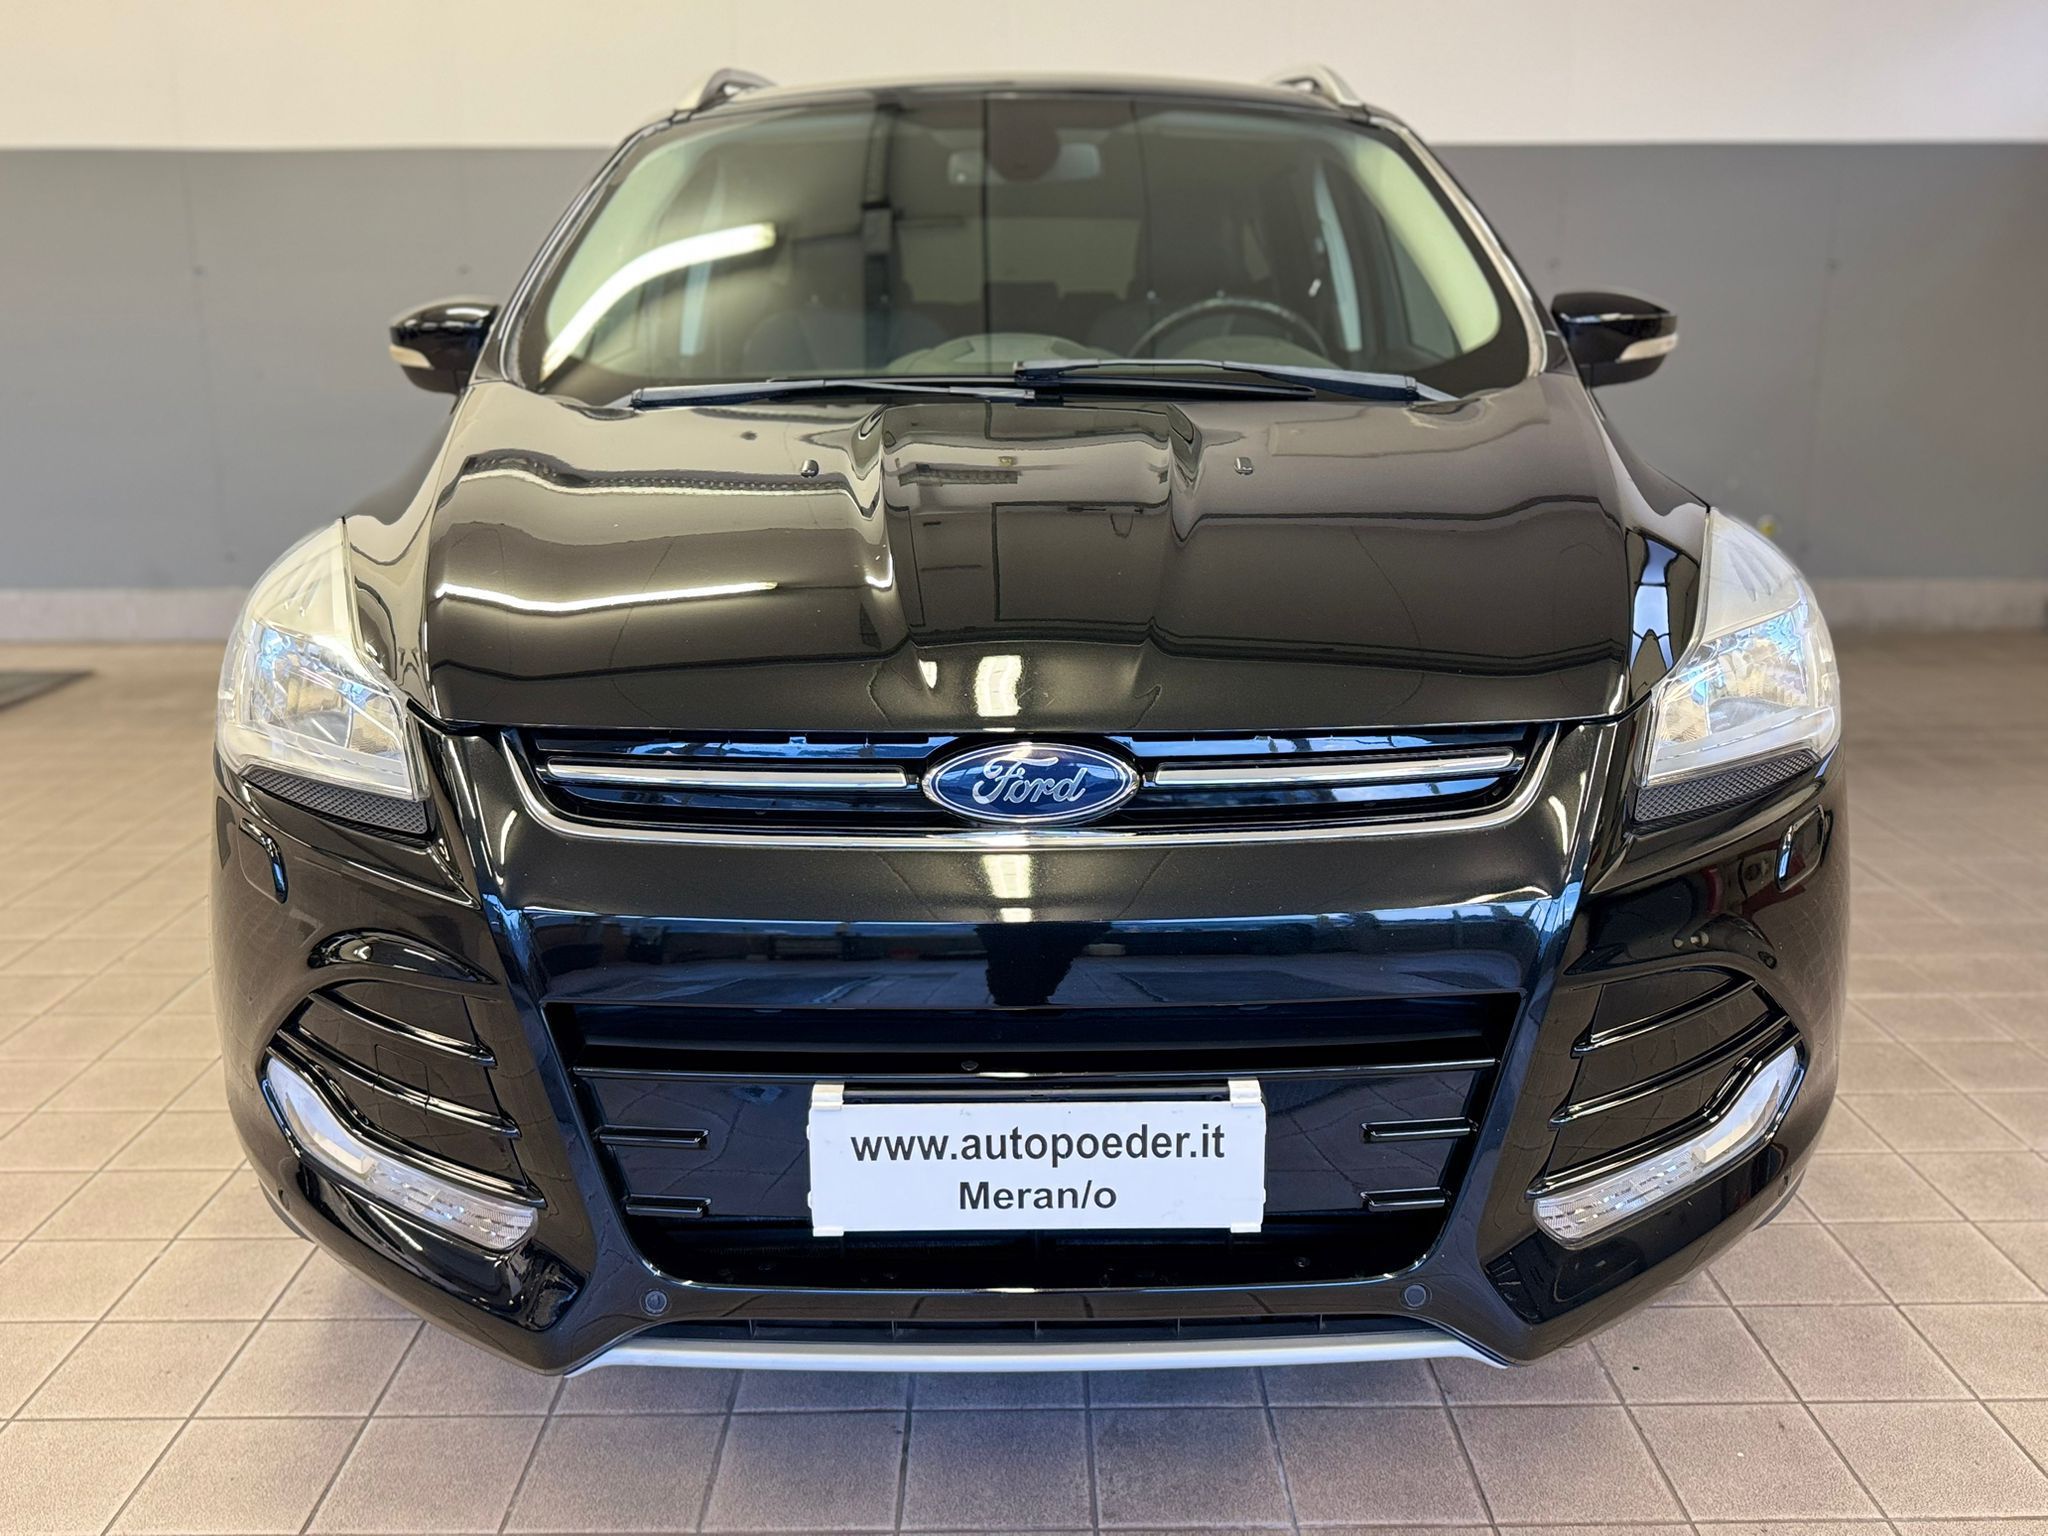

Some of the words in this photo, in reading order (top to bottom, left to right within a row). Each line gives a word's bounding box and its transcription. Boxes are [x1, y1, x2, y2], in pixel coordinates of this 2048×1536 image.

[971, 756, 1088, 804] Ford
[850, 1123, 1226, 1168] www.autopoeder.it
[959, 1179, 1118, 1210] Meran/o
